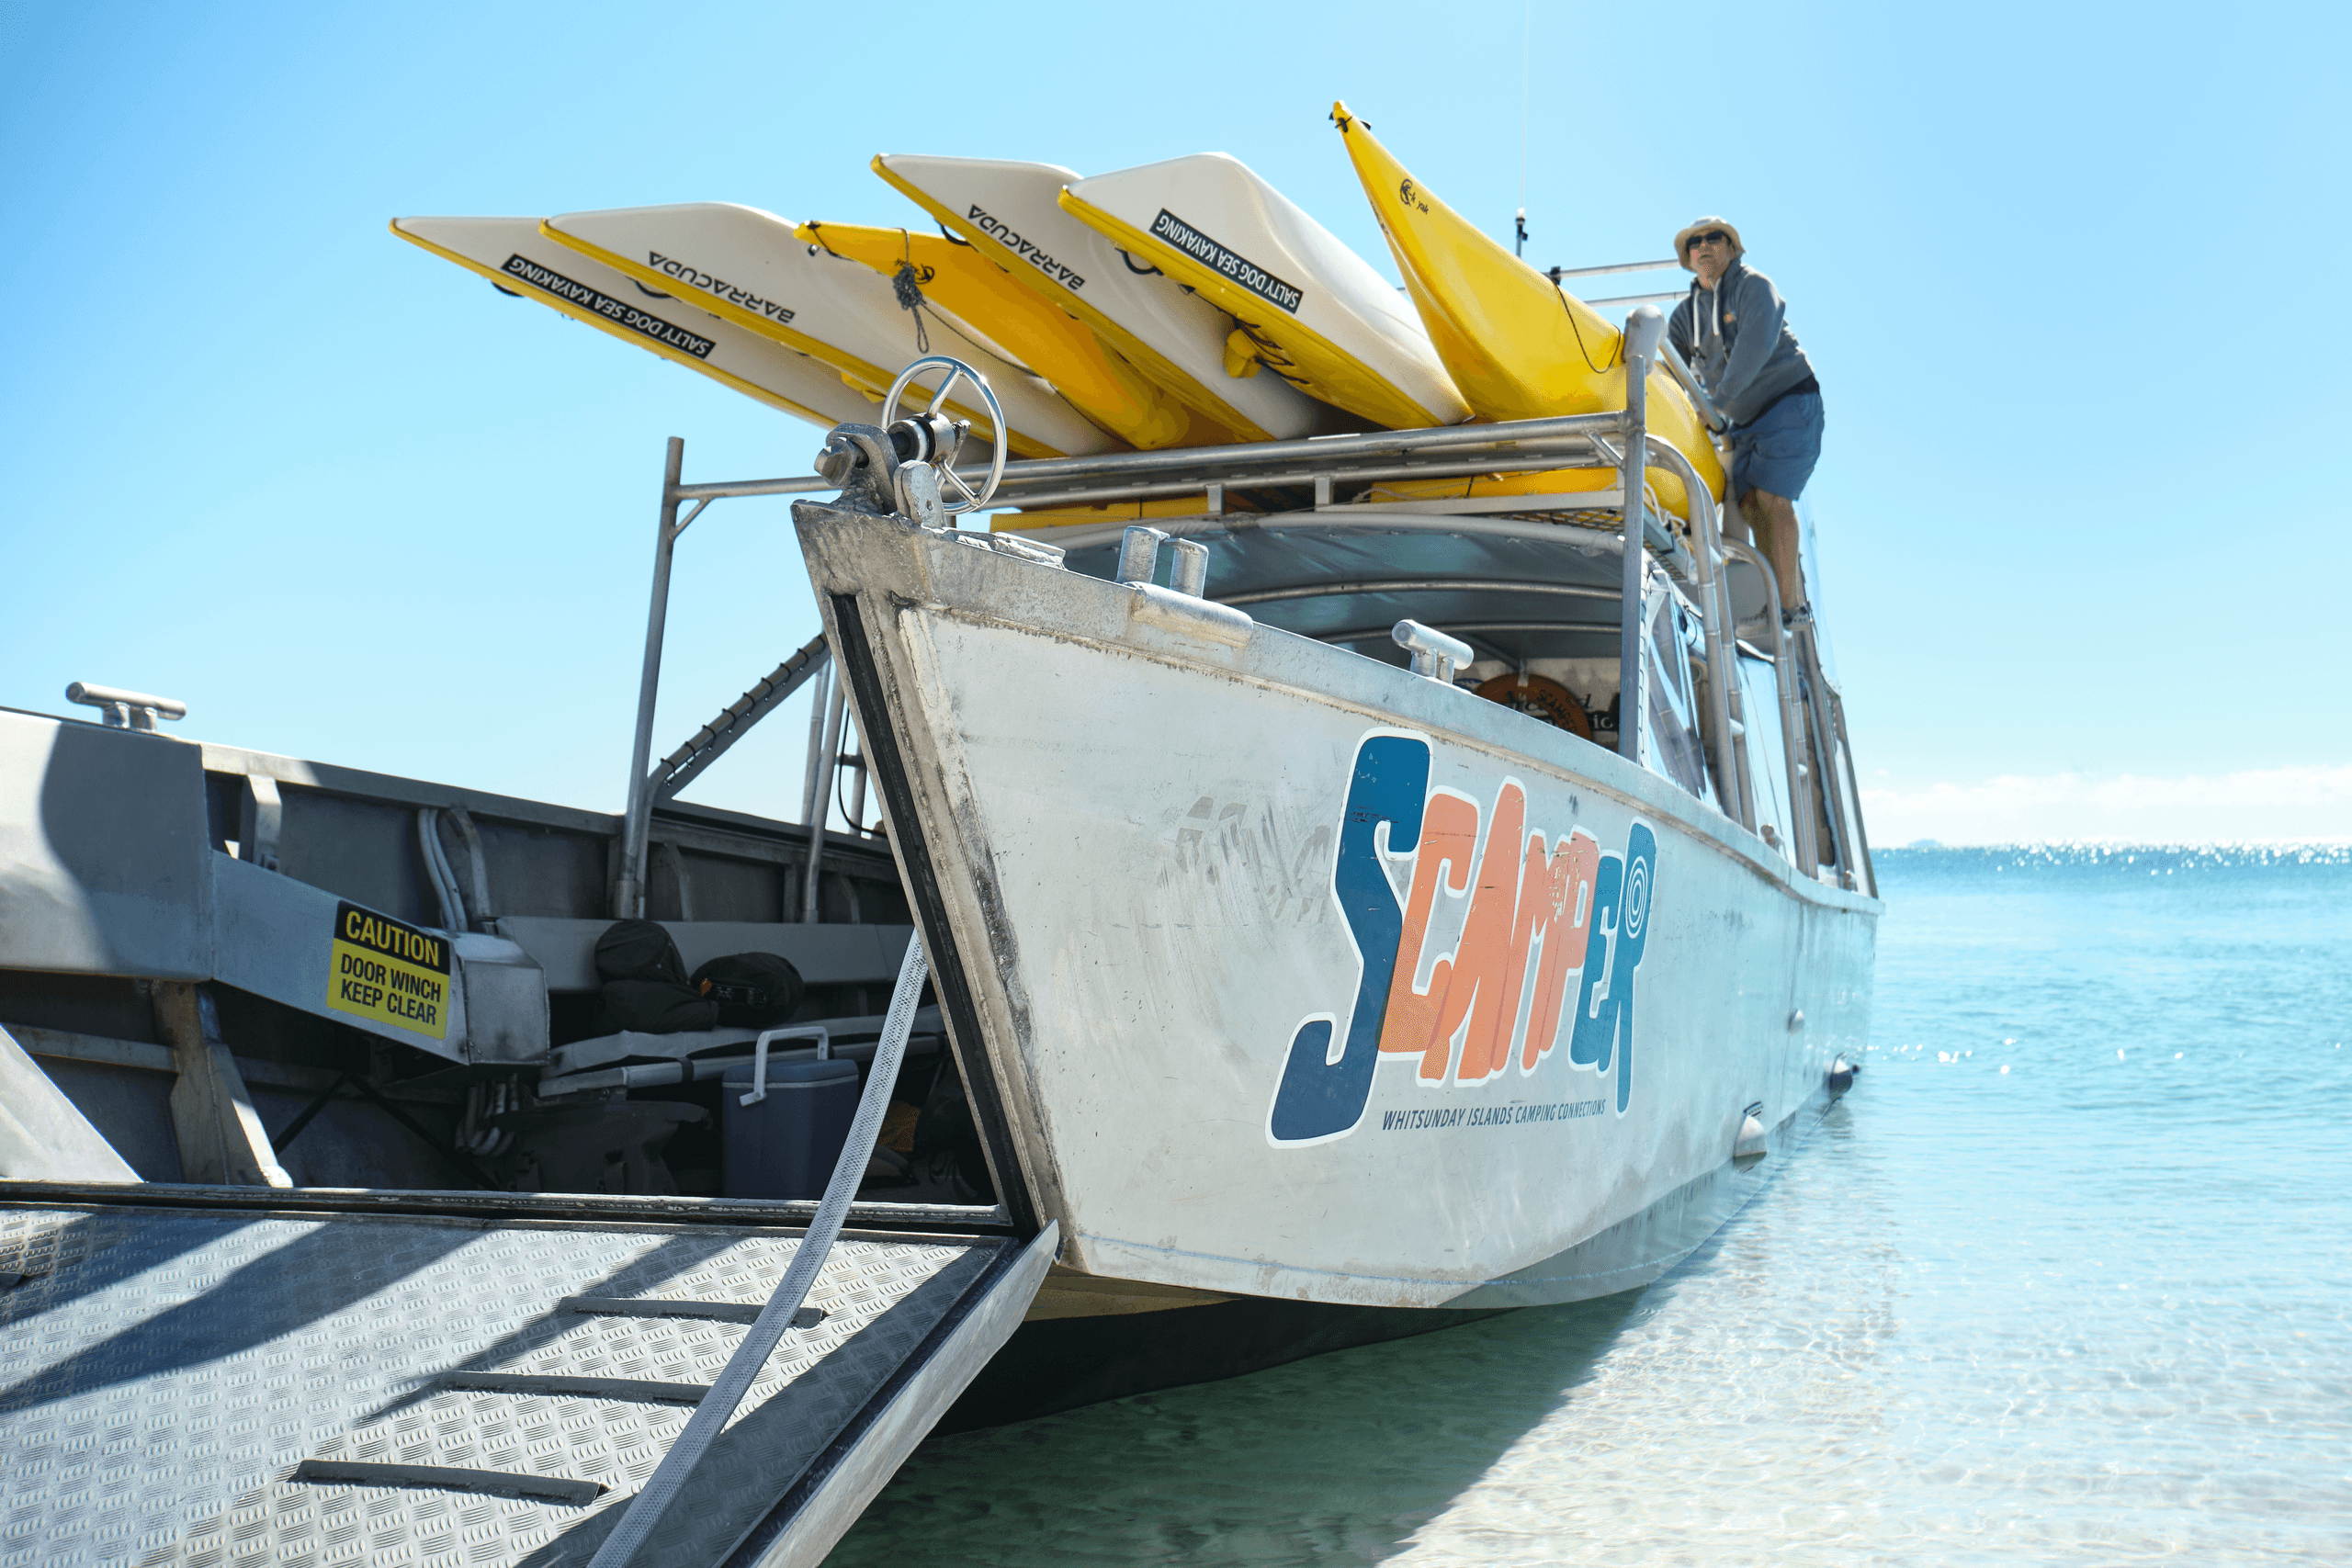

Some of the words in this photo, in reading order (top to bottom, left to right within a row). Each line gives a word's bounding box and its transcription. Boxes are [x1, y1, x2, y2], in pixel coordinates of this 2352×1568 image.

[967, 204, 1086, 291] BARRACUDA
[1156, 214, 1218, 263] KAYAKING
[508, 258, 594, 305] KAYAKING
[1216, 250, 1241, 276] SEA
[1238, 264, 1267, 290] DOG
[594, 296, 627, 318] SEA
[649, 251, 796, 324] BARRACUDA
[1264, 279, 1299, 308] SALTY
[624, 310, 664, 335] DOG
[662, 327, 710, 355] SALTY
[345, 911, 439, 966] CAUTION
[1267, 728, 1657, 1147] SCAMPER
[340, 953, 387, 986] DOOR
[390, 968, 441, 1002] WINCH
[340, 978, 383, 1008] KEEP
[387, 992, 437, 1026] CLEAR
[1382, 1108, 1467, 1131] WHITSUNDAY
[1466, 1106, 1514, 1126] ISLANDS
[1514, 1103, 1557, 1124] CAMPING
[1556, 1099, 1607, 1121] CONNECTIONS
